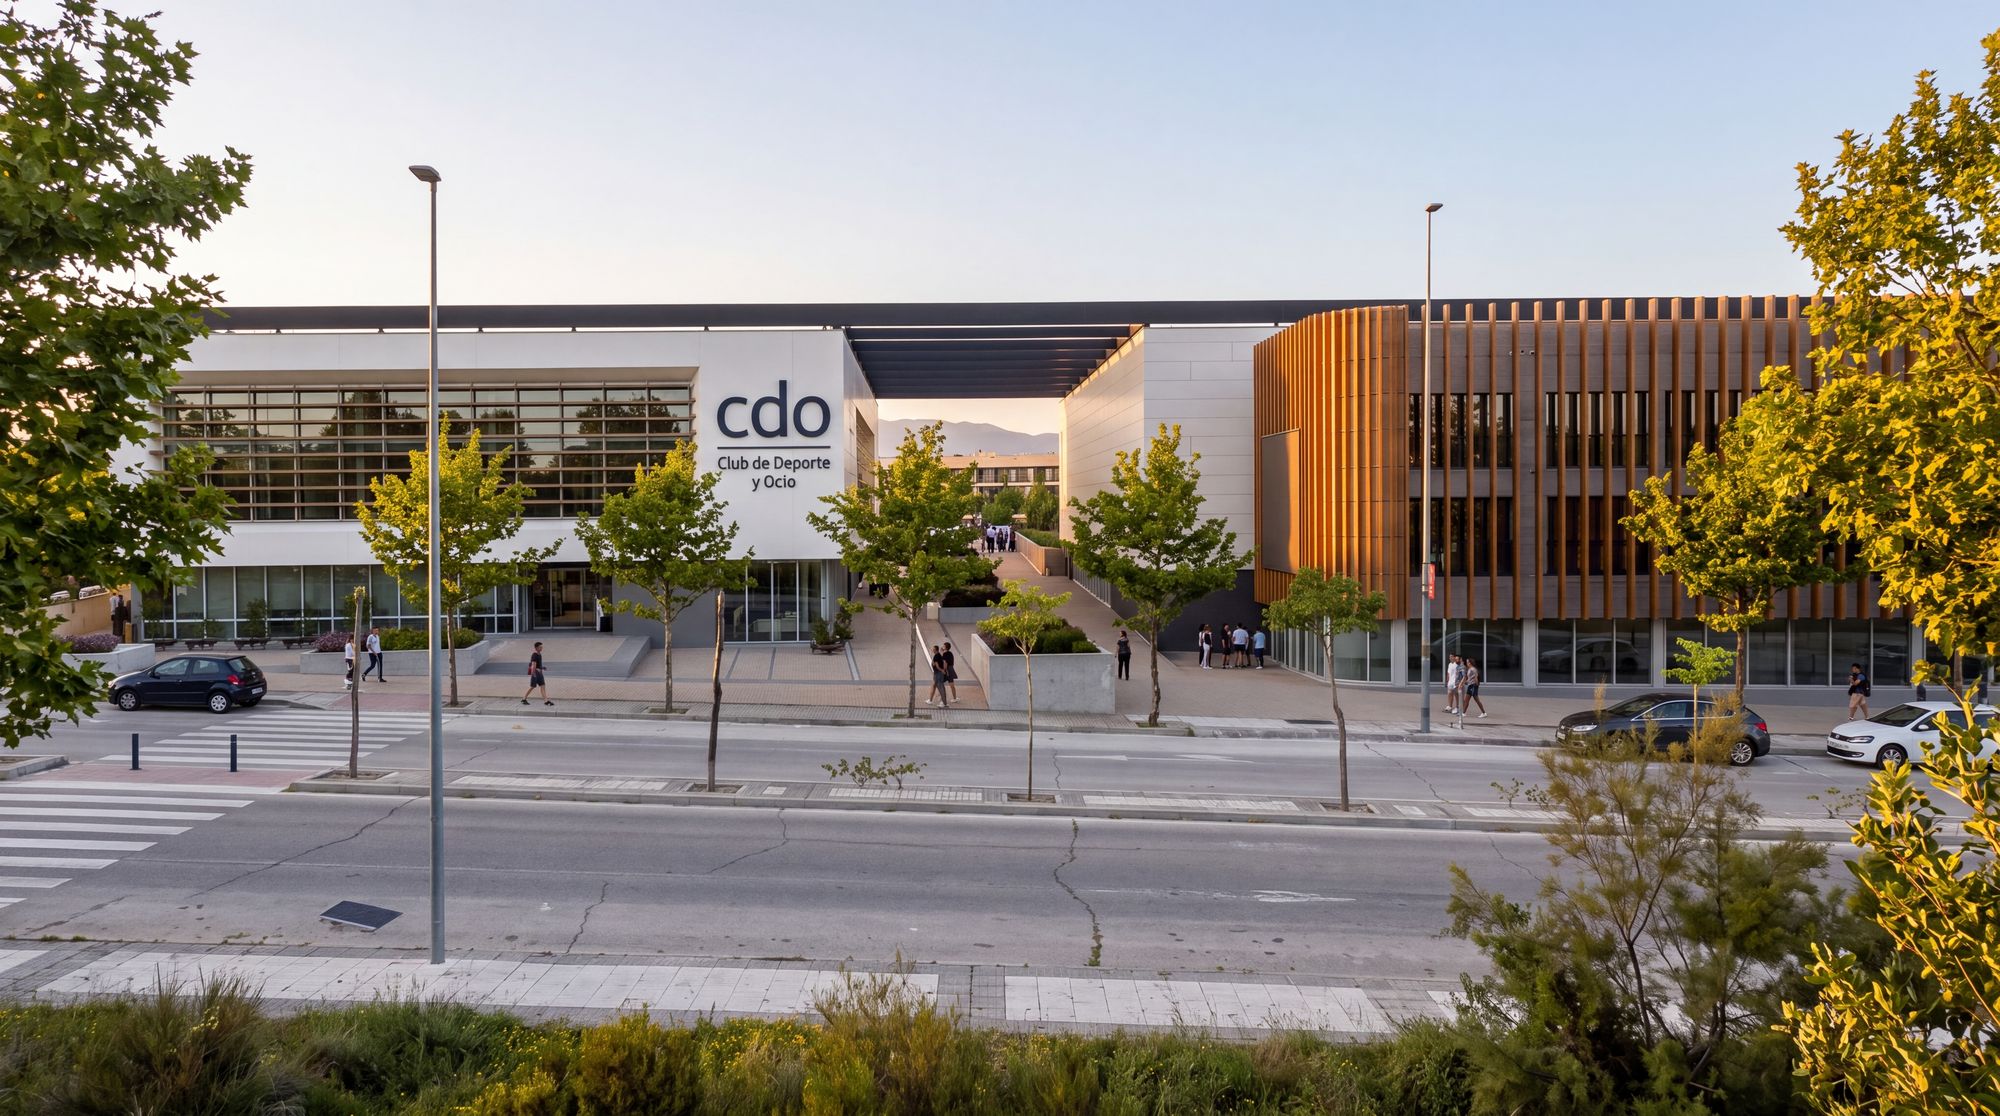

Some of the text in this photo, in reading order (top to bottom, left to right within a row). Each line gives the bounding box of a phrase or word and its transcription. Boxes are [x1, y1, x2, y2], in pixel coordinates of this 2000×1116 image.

[717, 379, 831, 438] cdo
[717, 456, 831, 473] Club de Deporte
[752, 475, 796, 492] y Ocio
